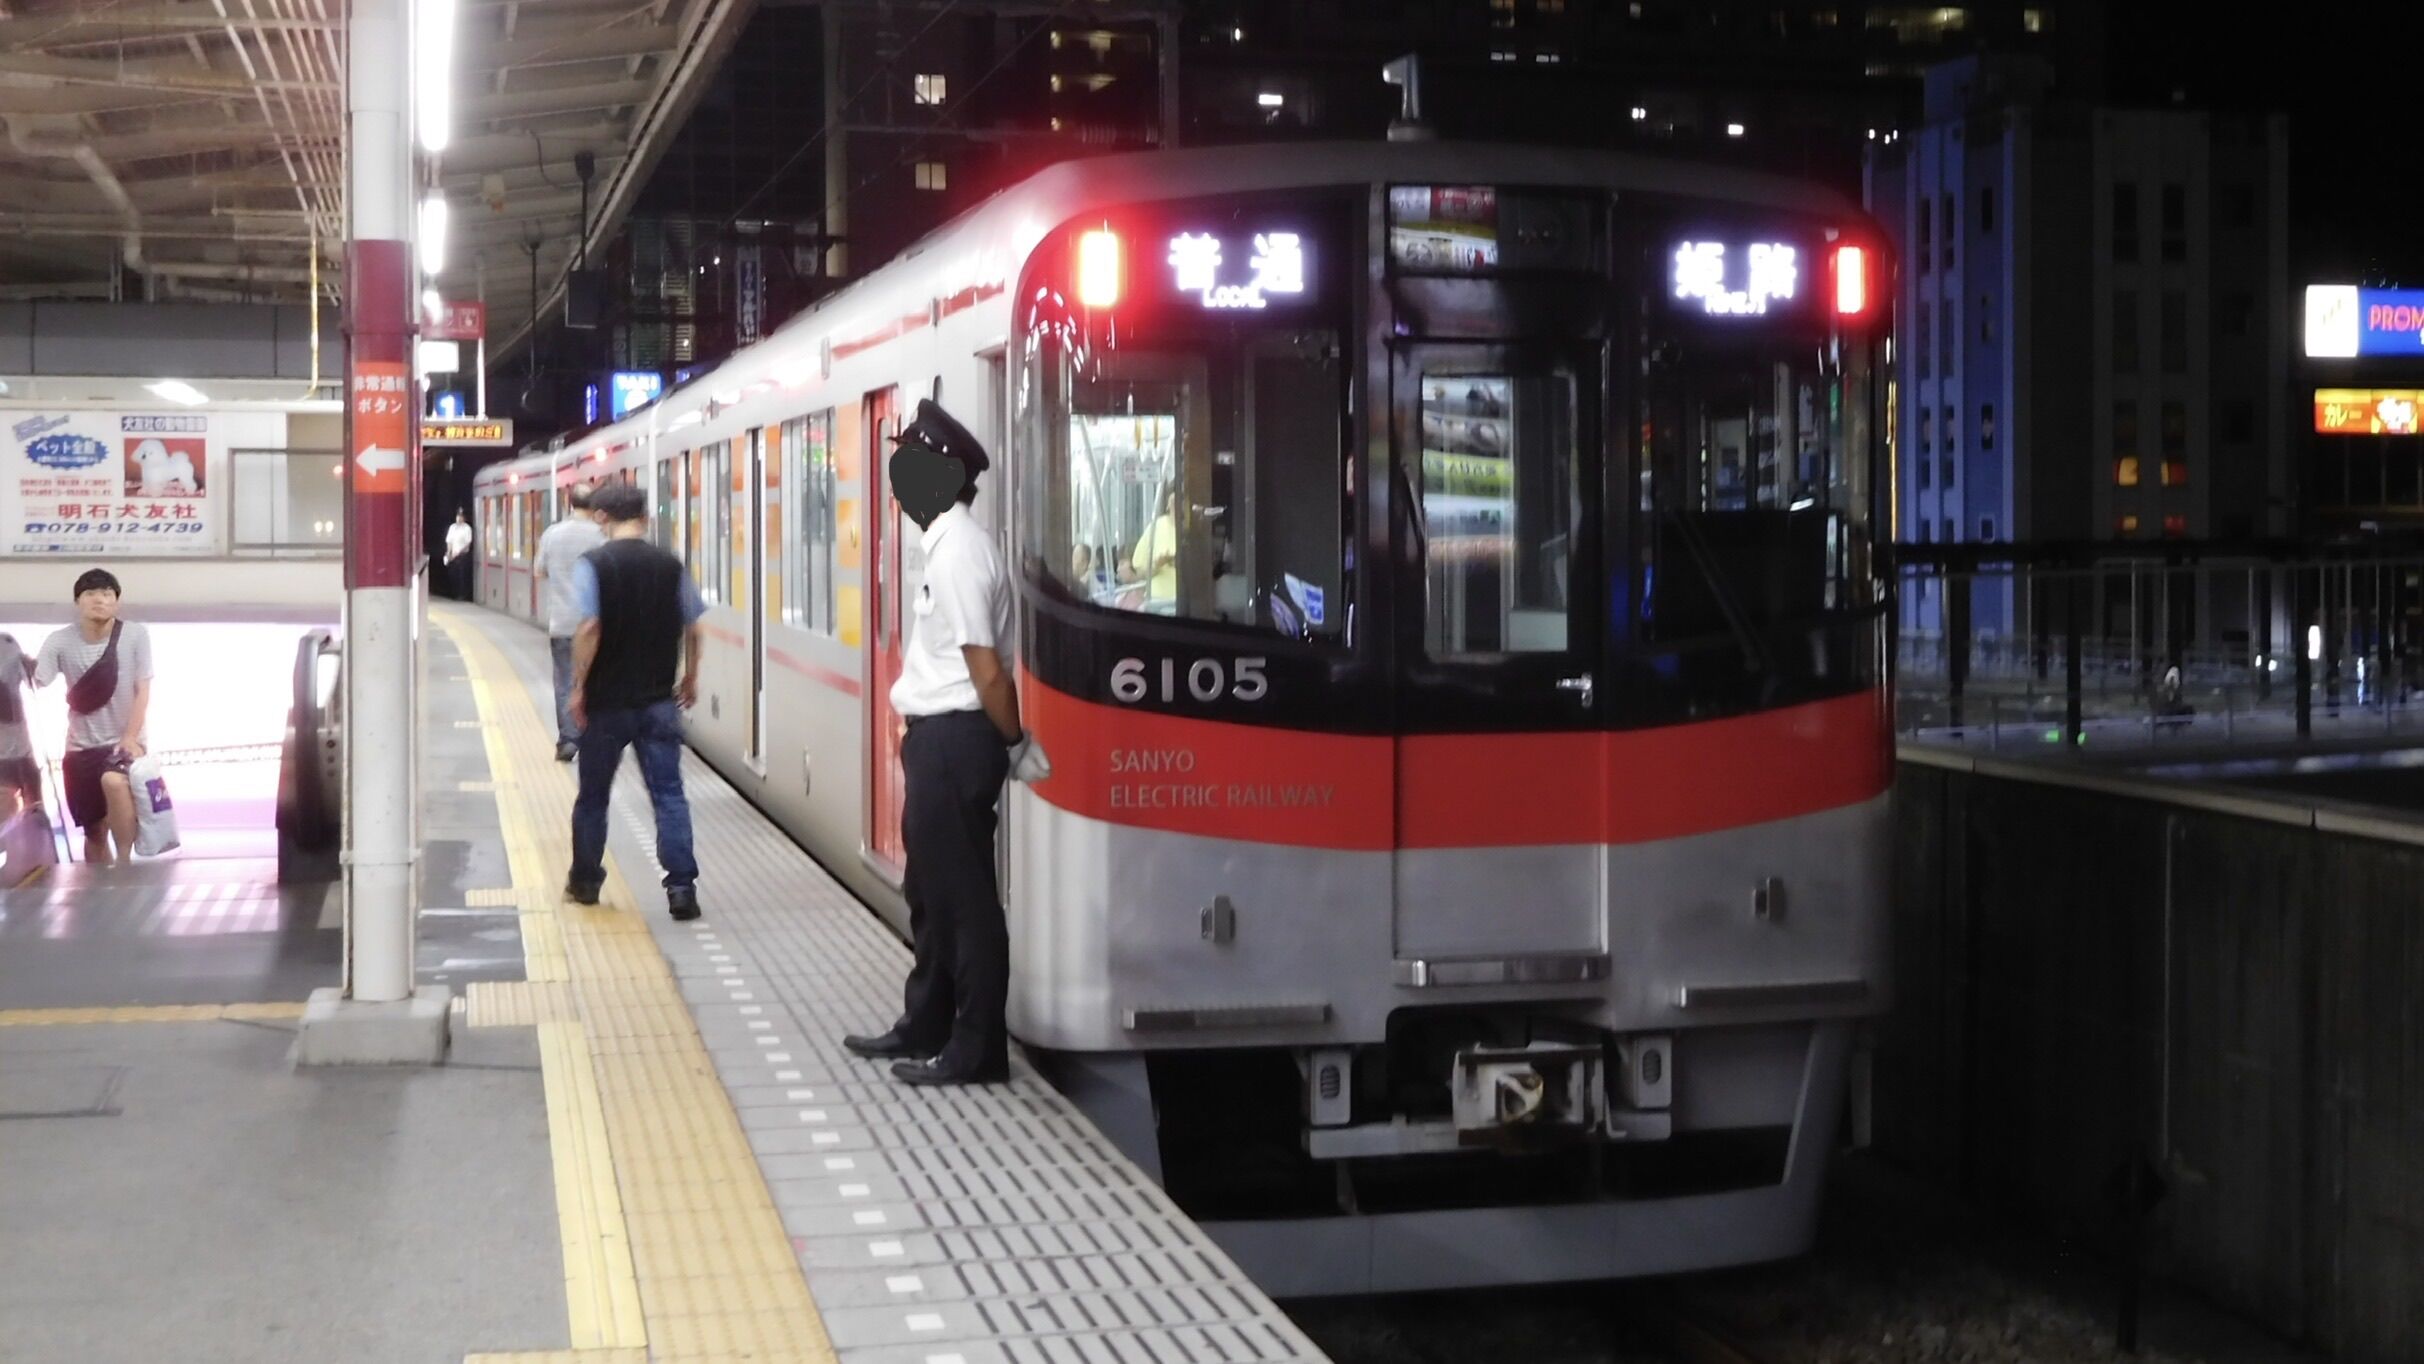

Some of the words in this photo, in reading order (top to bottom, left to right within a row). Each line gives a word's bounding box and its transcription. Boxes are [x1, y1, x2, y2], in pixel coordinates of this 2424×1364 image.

[1168, 232, 1304, 292] 普通
[358, 397, 402, 414] ボタン
[58, 504, 198, 519] 明石犬友社
[48, 522, 204, 534] 078-912-4739
[1110, 657, 1268, 702] 6105
[1110, 749, 1195, 773] SANYO
[1110, 783, 1220, 808] ELECTRIC
[1227, 784, 1335, 808] RAILWAY
